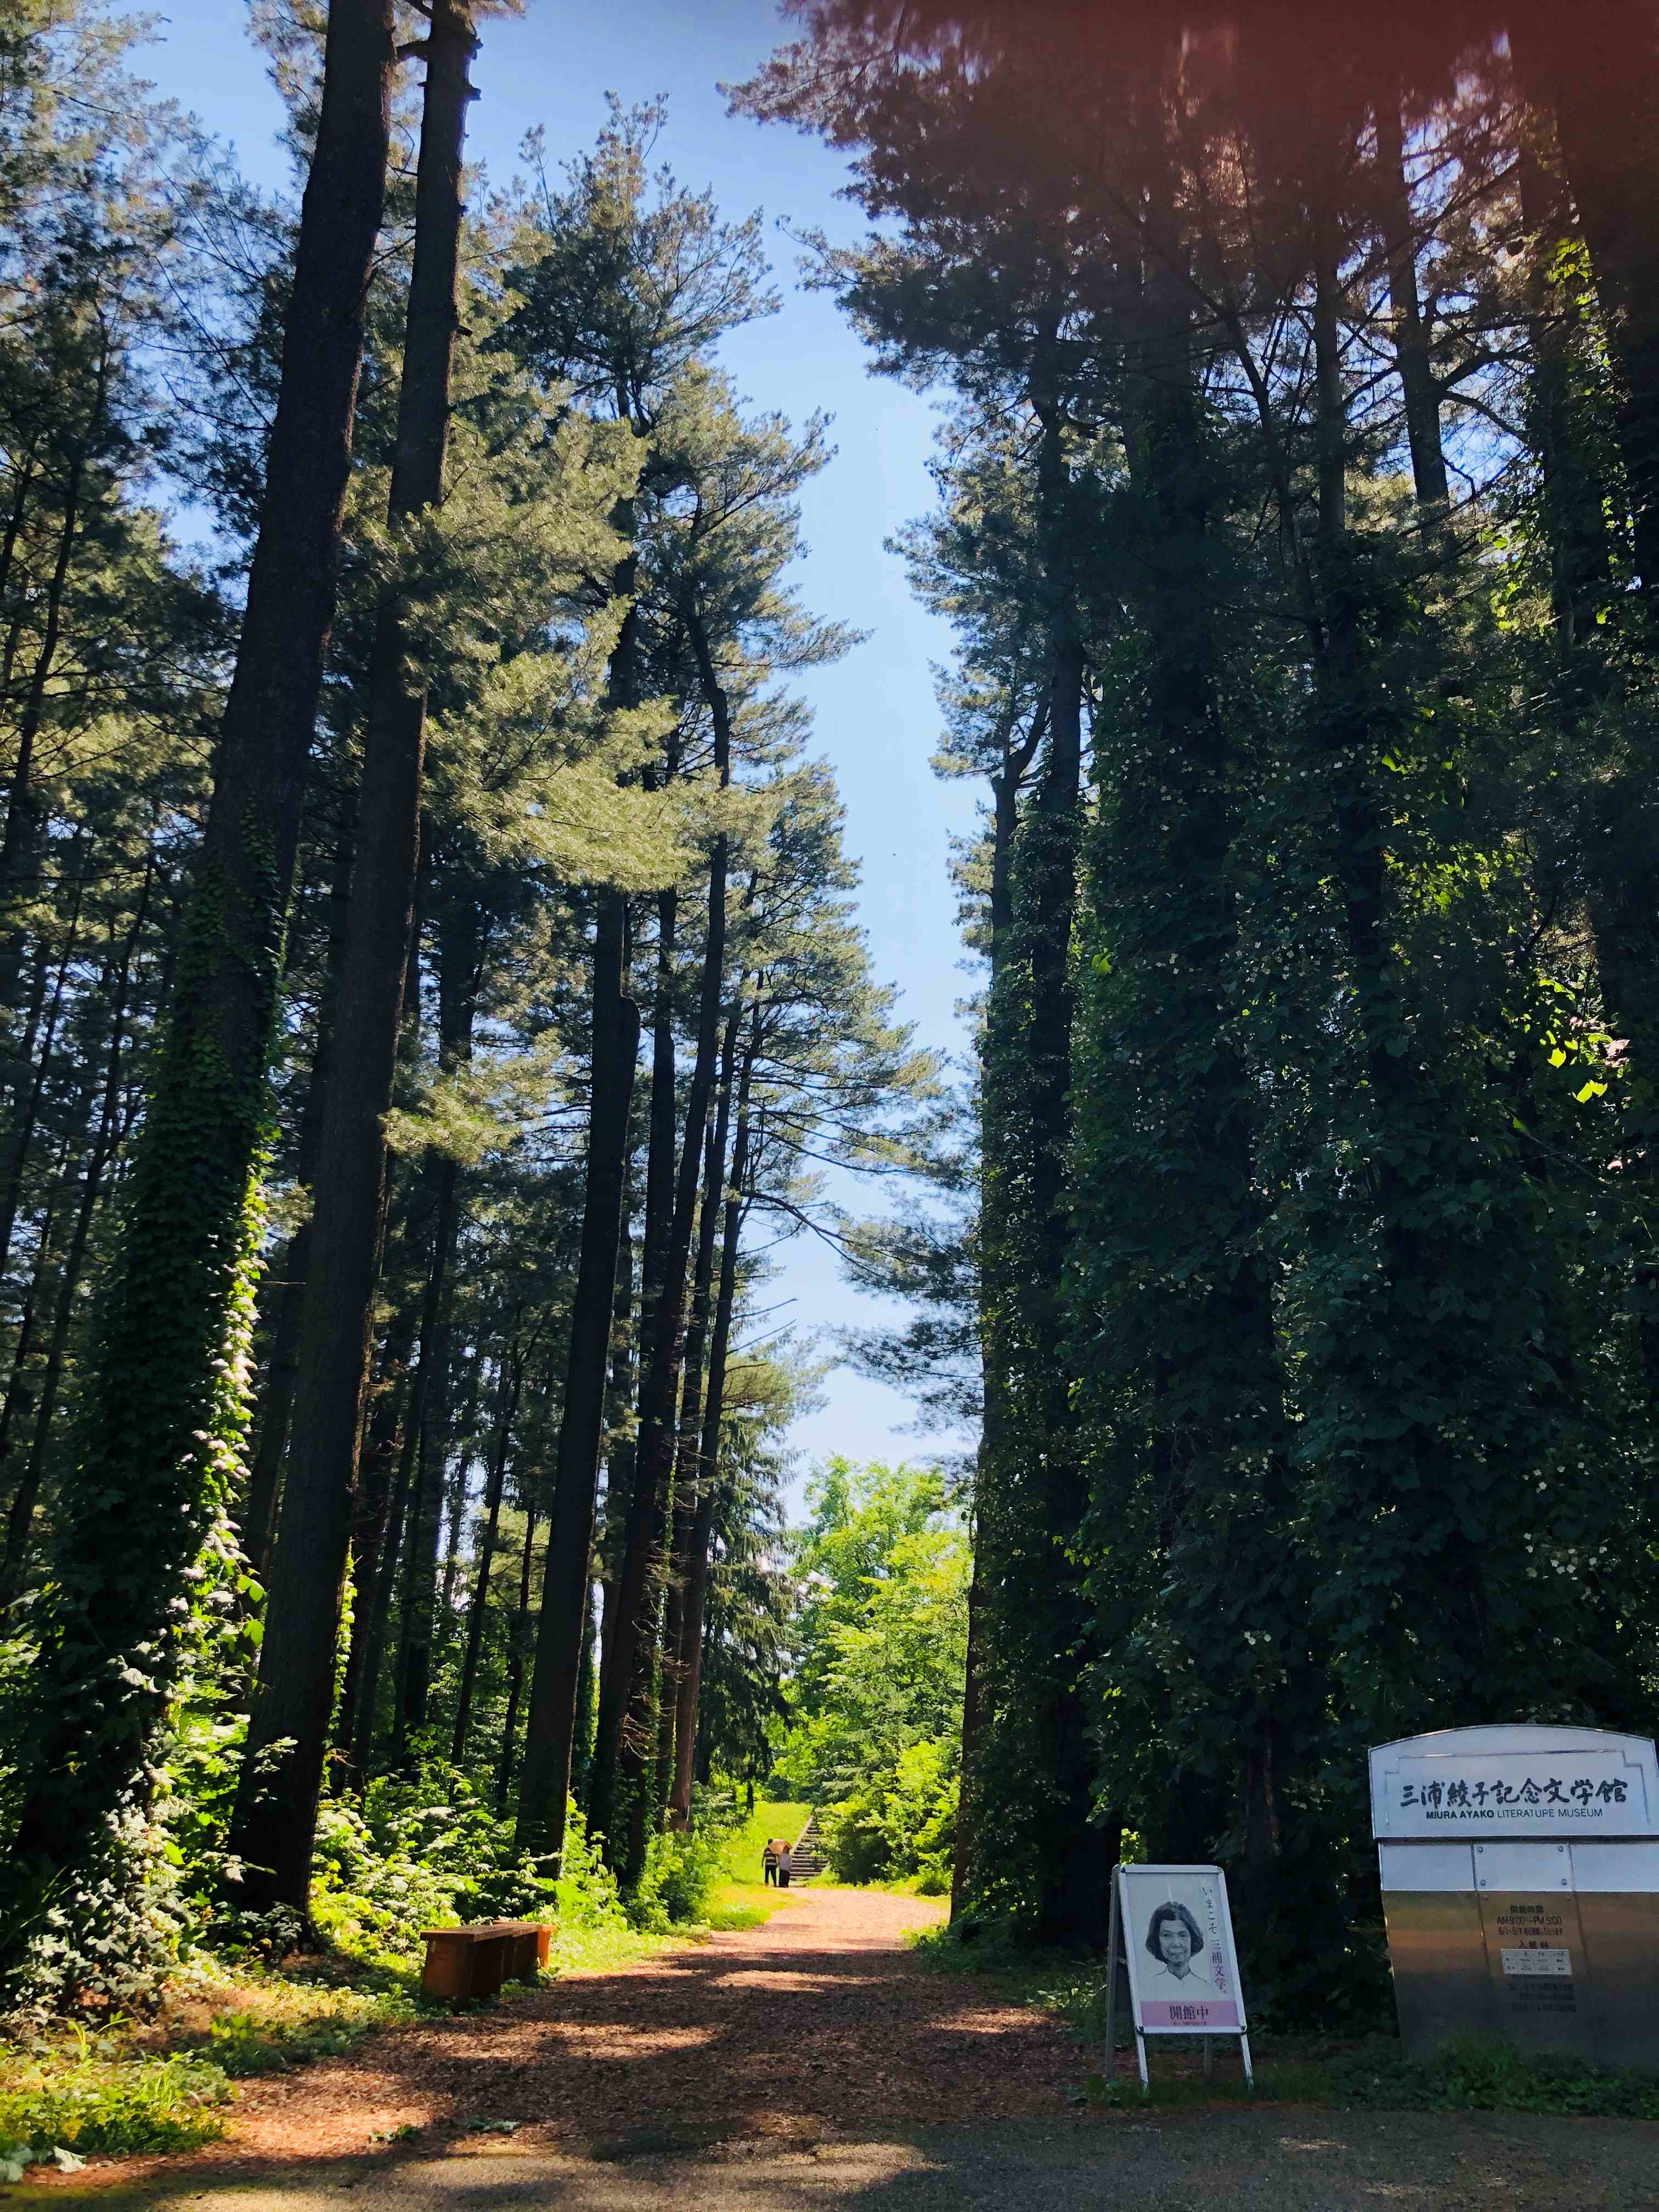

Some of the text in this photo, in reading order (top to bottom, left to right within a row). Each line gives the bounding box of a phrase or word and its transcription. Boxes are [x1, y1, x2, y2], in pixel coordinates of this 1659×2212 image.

[1400, 1777, 1628, 1809] 三浦綾子記念文学館
[1426, 1808, 1603, 1819] MIURA AYAKO LITERATURE MUSEUM
[1169, 2005, 1209, 2020] 開館中
